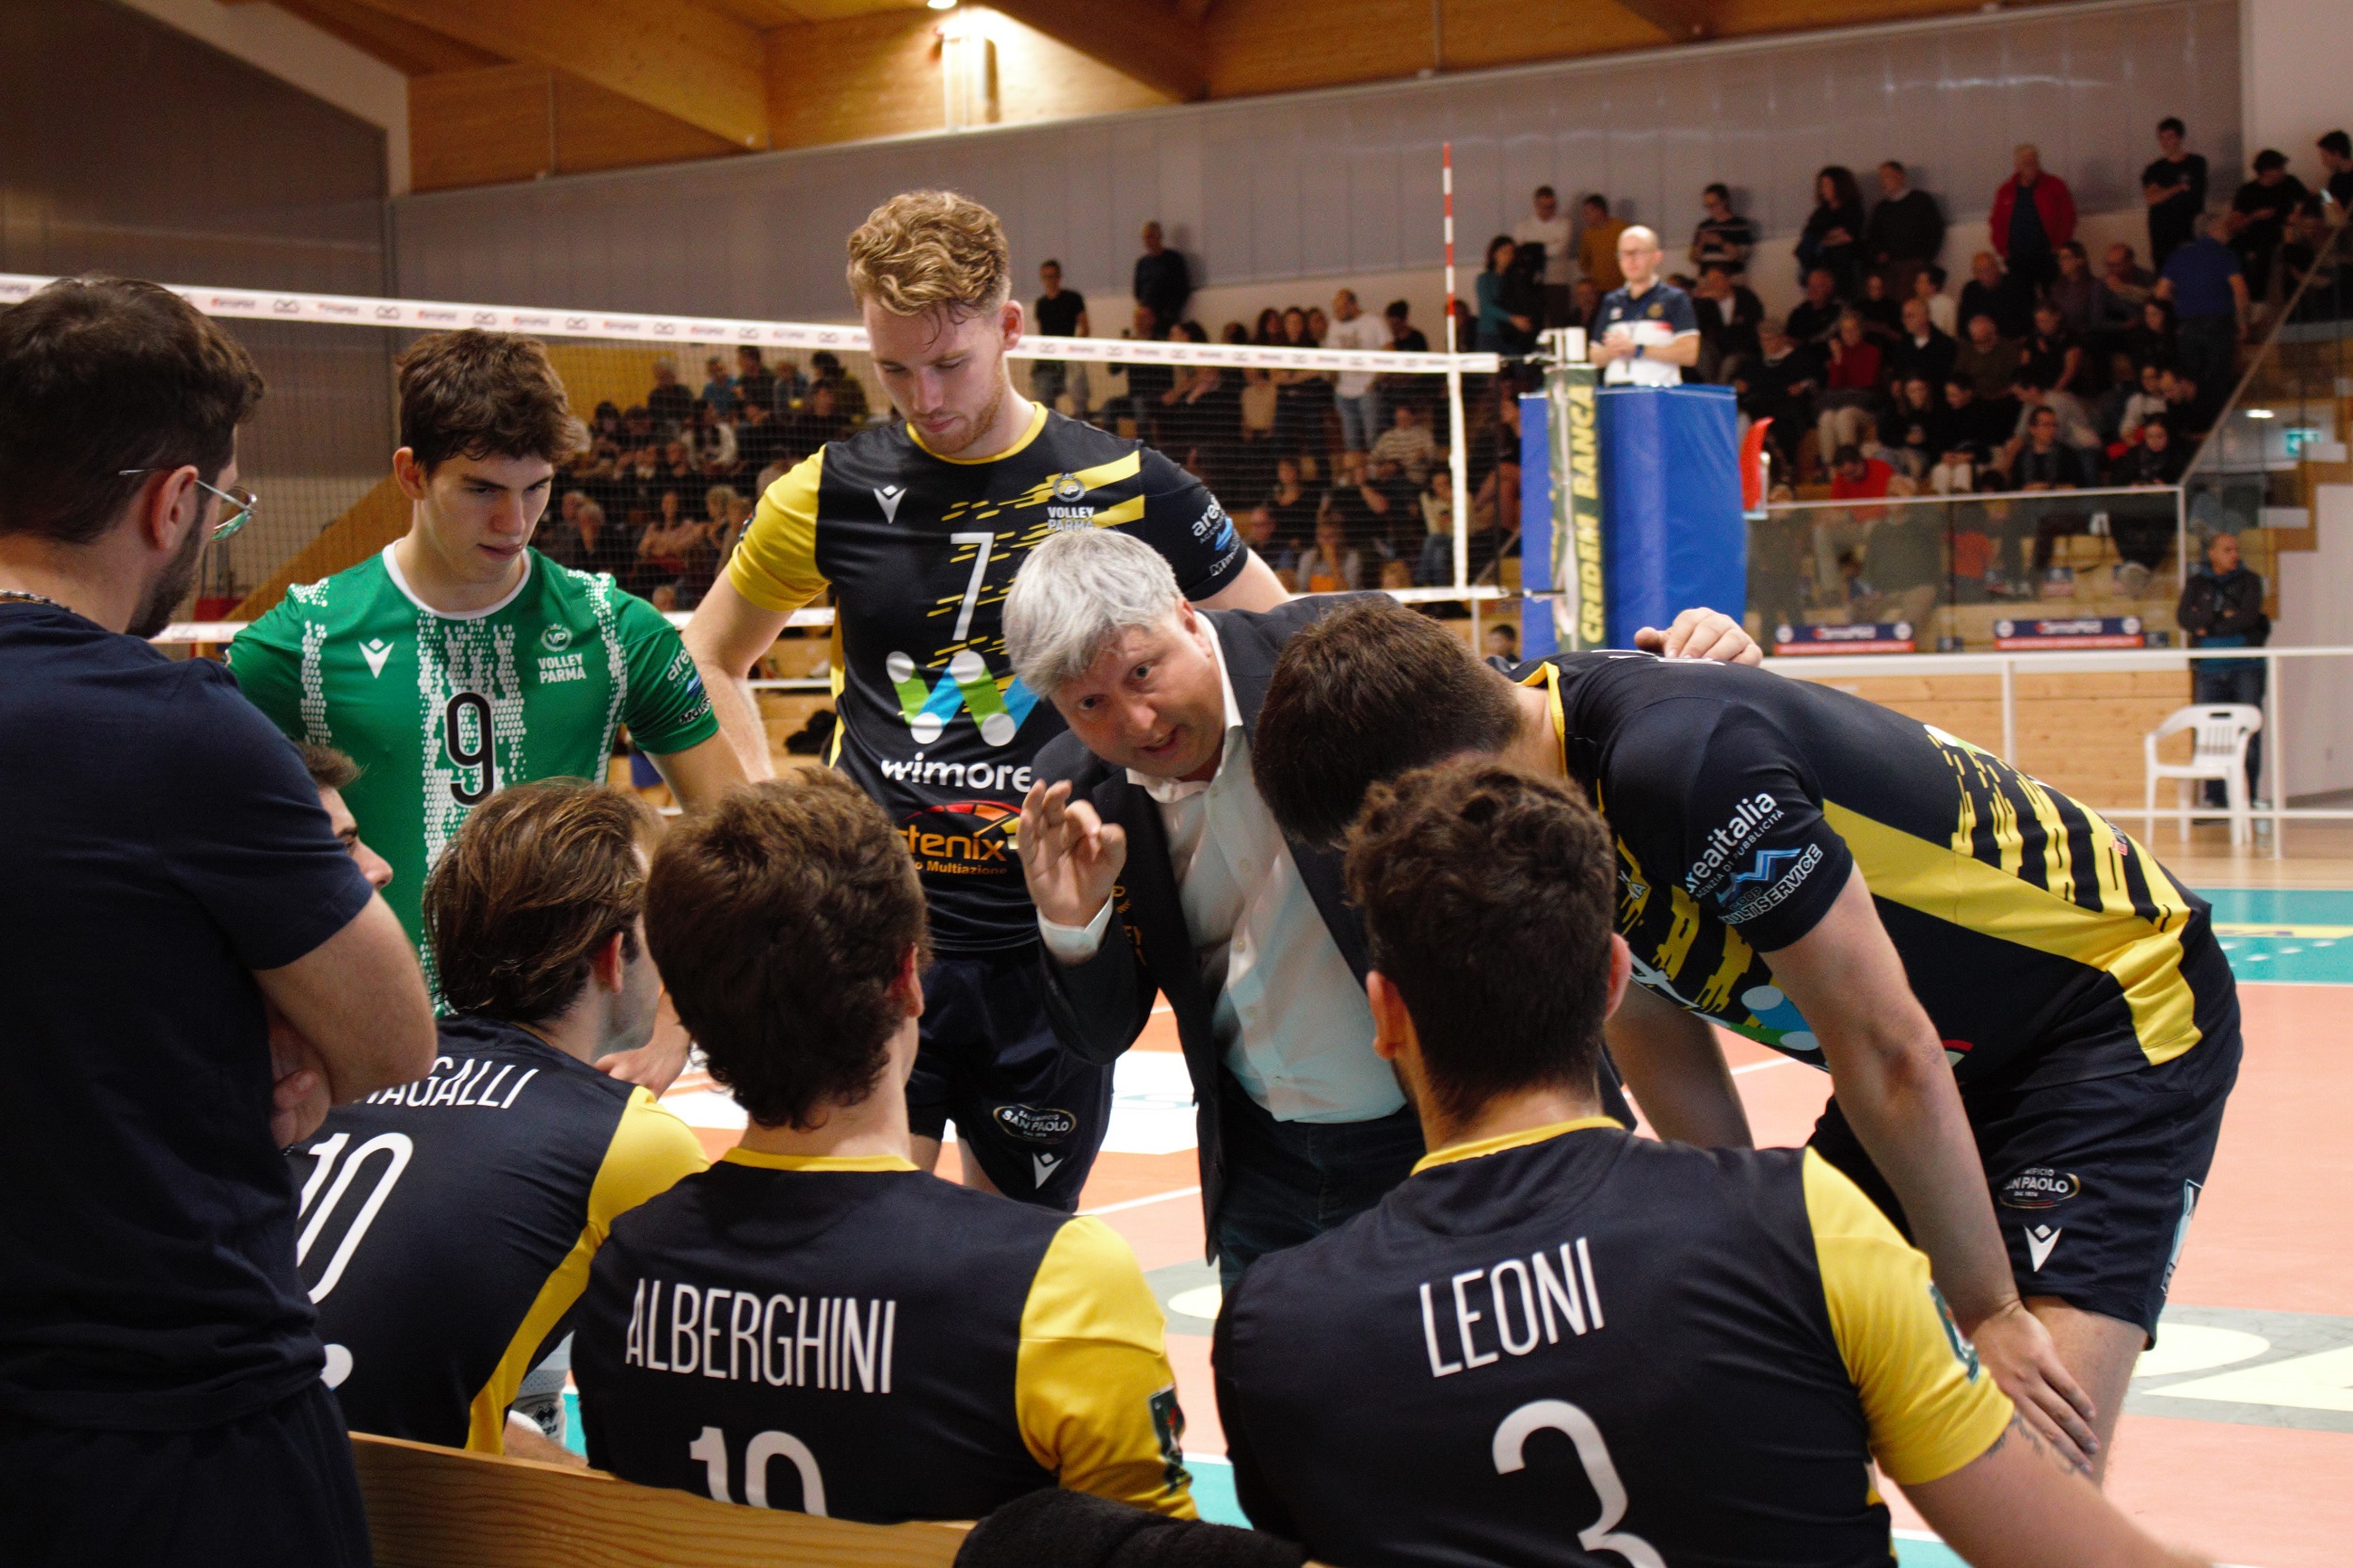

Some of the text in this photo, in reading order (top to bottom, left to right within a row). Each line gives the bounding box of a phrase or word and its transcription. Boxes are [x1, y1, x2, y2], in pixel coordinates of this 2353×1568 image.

[1047, 506, 1095, 519] VOLLEY
[1567, 384, 1604, 644] CREDEM BANCA
[1047, 518, 1094, 533] PARMA
[951, 533, 995, 641] 7
[537, 653, 583, 670] VOLLEY
[539, 666, 586, 684] PARMA
[445, 691, 495, 808] 9
[881, 751, 1032, 792] wimore
[926, 860, 1008, 875] Multiazione
[1722, 860, 1736, 873] DI
[1728, 886, 1763, 910] COOP
[1001, 1110, 1070, 1131] SAN PAOLO
[2021, 1176, 2070, 1193] PAOLO
[296, 1132, 413, 1304] 10
[1418, 1236, 1607, 1379] LEONI
[625, 1277, 897, 1395] ALBERGHINI
